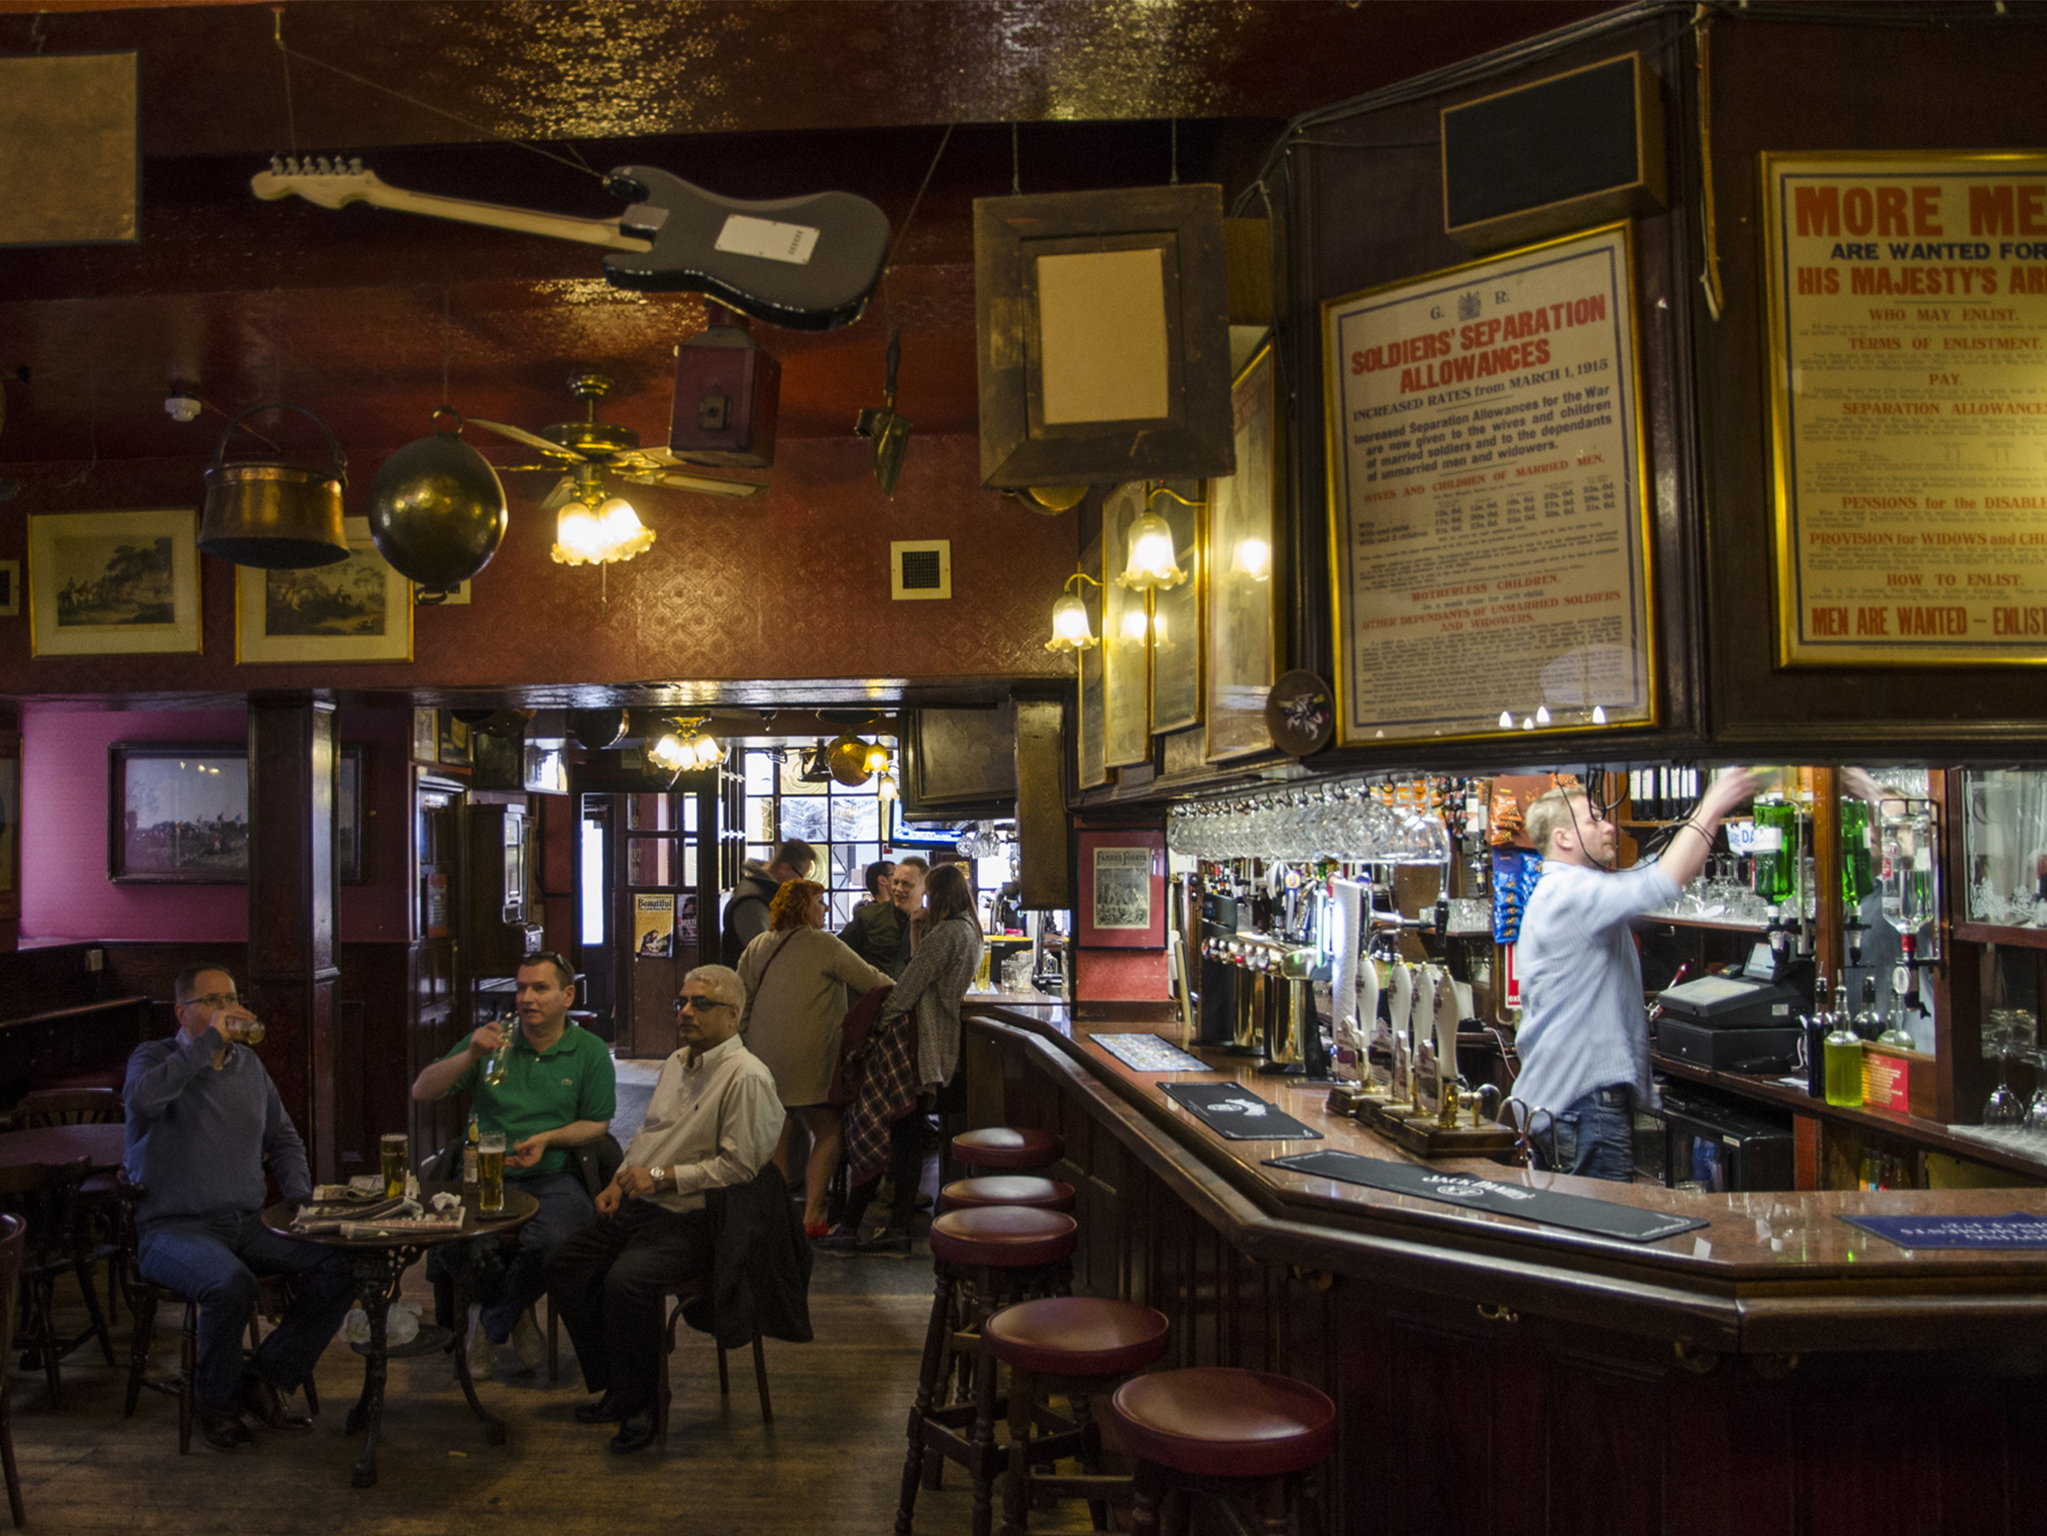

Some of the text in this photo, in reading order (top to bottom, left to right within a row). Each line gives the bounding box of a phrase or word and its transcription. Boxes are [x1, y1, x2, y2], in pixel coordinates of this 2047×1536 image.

[1795, 185, 2047, 237] MORE ME
[1831, 242, 2047, 260] ARE WANTED FOR
[1797, 266, 2047, 295] HIS MAJESTY'S AR
[1869, 309, 1906, 321] WHO
[1918, 308, 1950, 321] MAY
[1351, 294, 1606, 376] SOLDIERS' SEPARATION
[1849, 337, 2044, 350] TERMS OF ENLISTMENT.
[1400, 339, 1551, 395] ALLOWANCES
[1928, 373, 1964, 386] PAY.
[1353, 397, 1424, 422] INCREASED
[1427, 387, 1471, 406] RATES
[1475, 382, 1505, 397] from
[1509, 369, 1560, 390] MARCH
[1578, 358, 1608, 376] 1915
[1354, 385, 1610, 445] Increased Separation Allowances for the War
[1842, 402, 1940, 415] SEPARATION
[1366, 400, 1611, 456] are now given to the wives and children
[1380, 450, 1423, 467] married
[1427, 442, 1471, 458] soldiers
[1475, 434, 1496, 449] and
[1501, 433, 1512, 444] to
[1517, 429, 1536, 442] the
[1541, 414, 1612, 437] dependants
[1381, 460, 1437, 480] unmarried
[1442, 456, 1466, 469] men
[1472, 450, 1492, 464] and
[1497, 440, 1559, 459] widowers.
[1403, 484, 1425, 497] AND
[1432, 474, 1486, 492] CHILDREN
[1493, 470, 1507, 481] OF
[1515, 459, 1569, 478] MARRIED
[1842, 496, 1917, 510] PENSIONS
[1925, 497, 1947, 510] for
[1954, 497, 1977, 509] the
[1809, 532, 2047, 546] PROVISION for WIDOWS and CHI
[1411, 583, 1488, 602] MOTHERLESS
[1886, 573, 1923, 586] HOW
[1934, 573, 1956, 586] TO
[1362, 590, 1621, 630] OTHER DEPENDANTS OF UNMARRIED SOLDIERS
[1811, 606, 1849, 636] MEN
[1856, 606, 1889, 636] ARE
[1897, 606, 1967, 636] WANTED
[1993, 606, 2047, 636] ENLIST
[1440, 620, 1463, 632] AND
